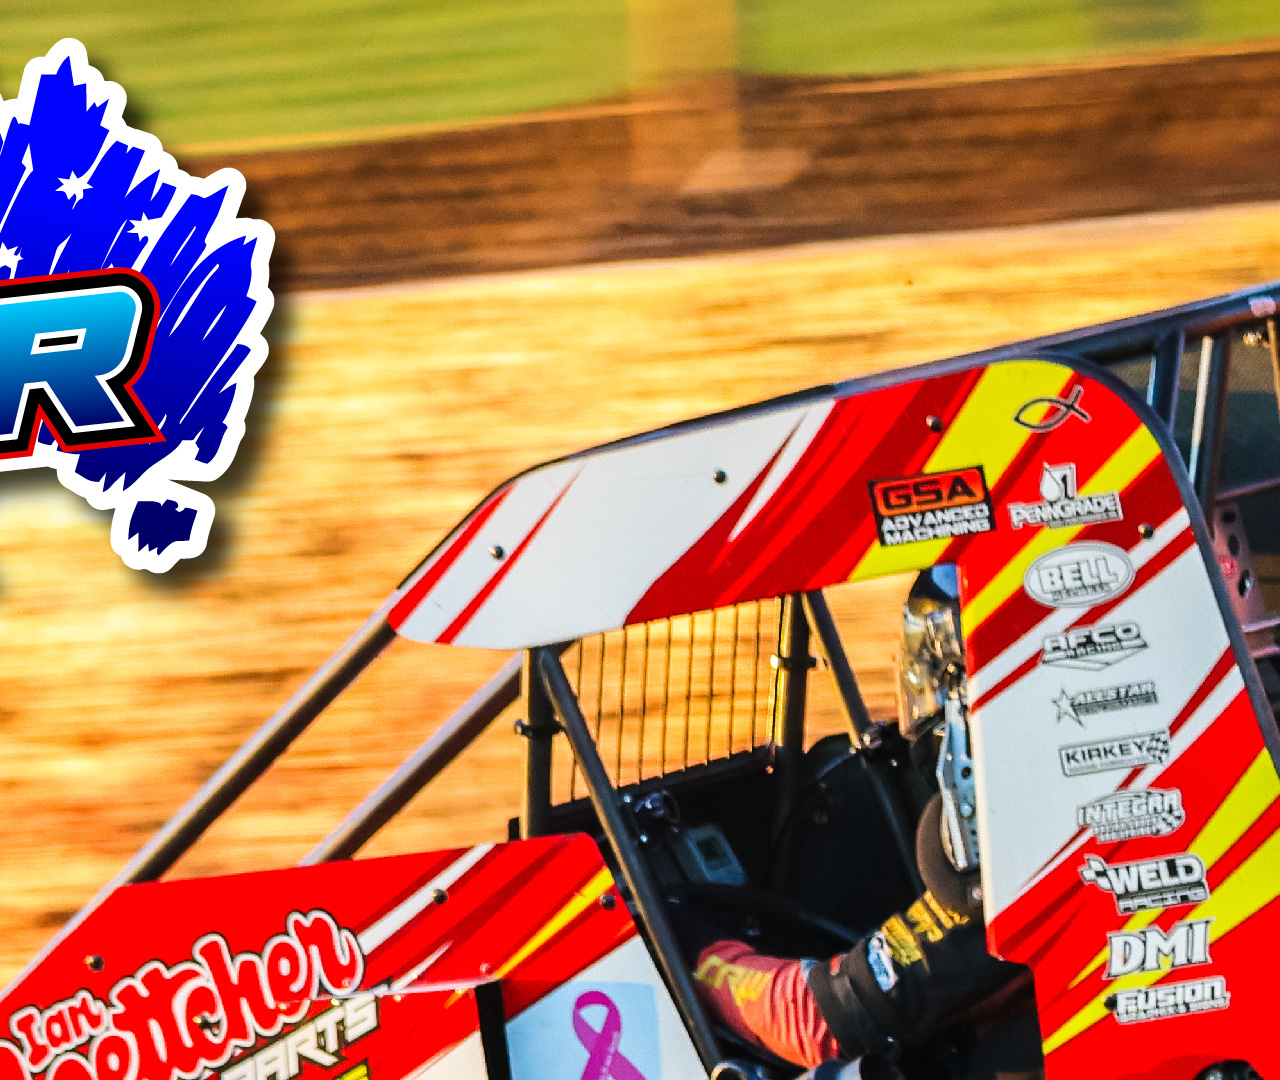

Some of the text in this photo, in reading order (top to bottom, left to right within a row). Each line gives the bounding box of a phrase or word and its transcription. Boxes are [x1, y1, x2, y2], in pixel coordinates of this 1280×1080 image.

[882, 474, 977, 511] GSA
[881, 502, 990, 531] ADVANCED
[884, 518, 991, 545] MACHINING
[1039, 555, 1116, 594] BELL
[1044, 624, 1139, 651] AFCO
[1065, 740, 1146, 764] KIRKEY
[1078, 793, 1178, 826] INTEGRA
[1107, 857, 1204, 896] WELD
[1107, 921, 1210, 977] DMI
[12, 988, 107, 1069] Ian
